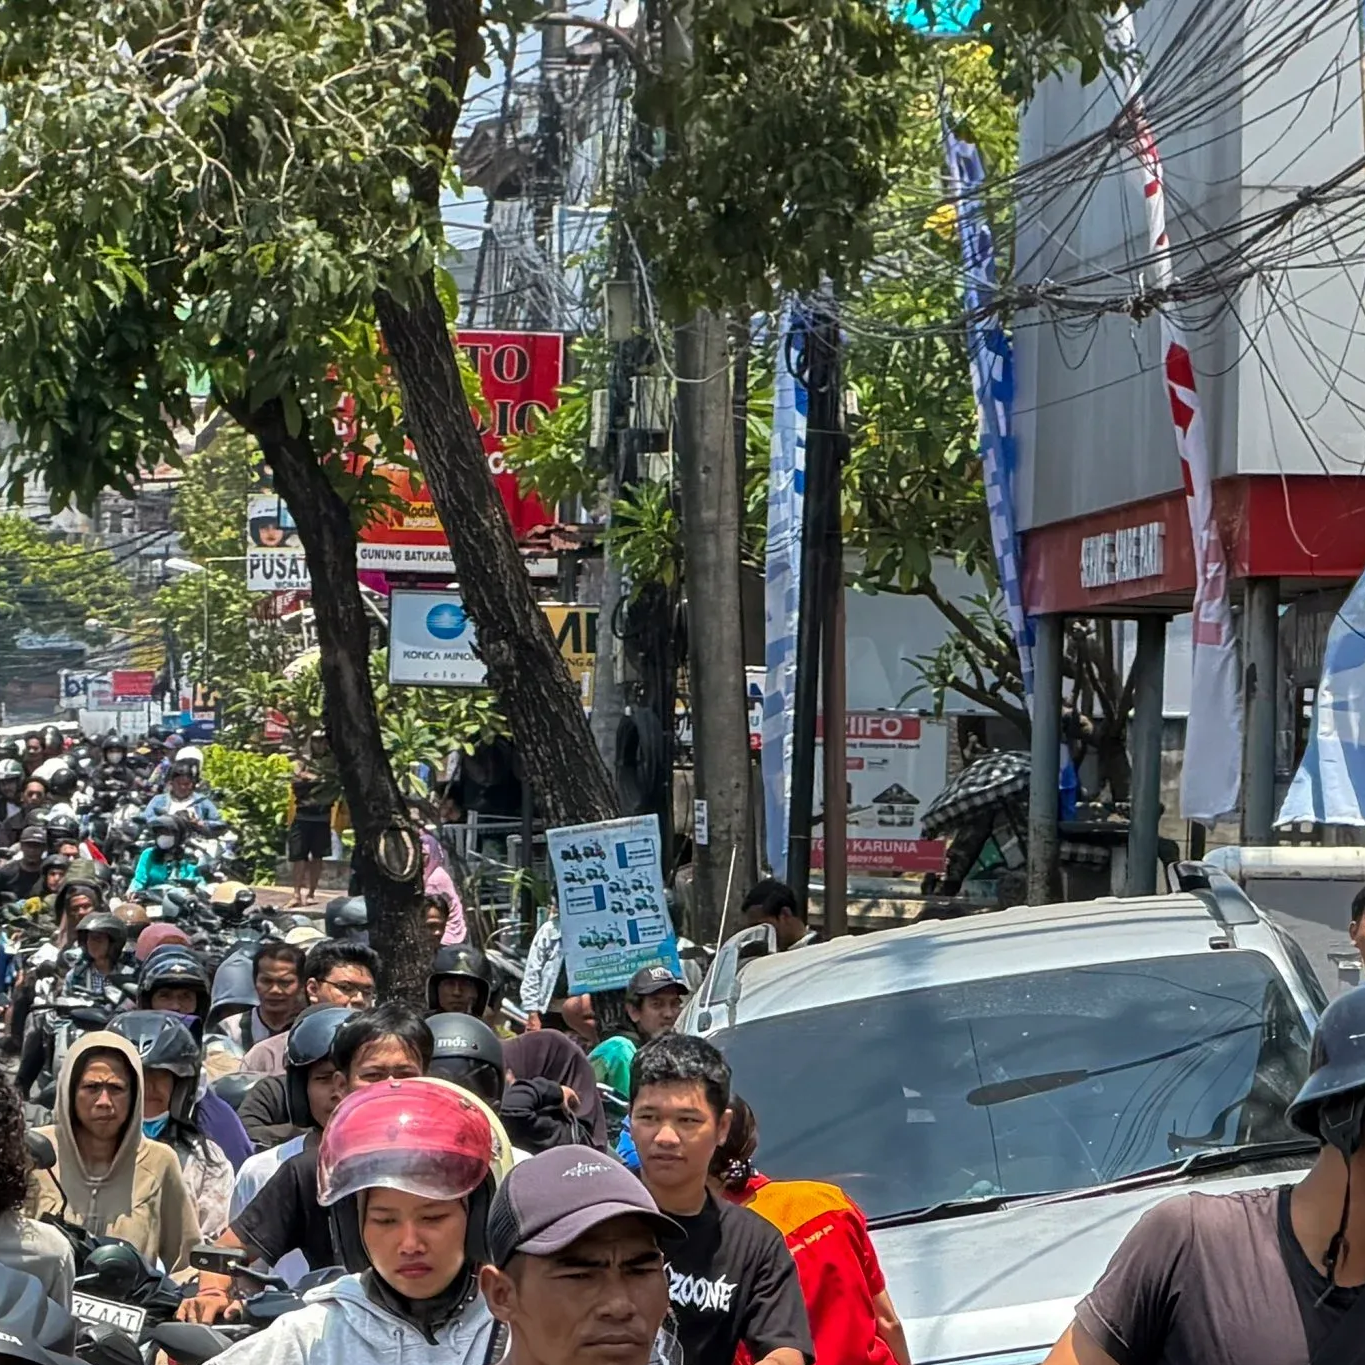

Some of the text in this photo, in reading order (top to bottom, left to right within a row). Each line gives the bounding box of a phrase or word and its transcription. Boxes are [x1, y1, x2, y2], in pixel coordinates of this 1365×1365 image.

[360, 548, 402, 560] GUNUNG
[403, 650, 440, 660] KONICA
[853, 842, 918, 853] KARUNIA
